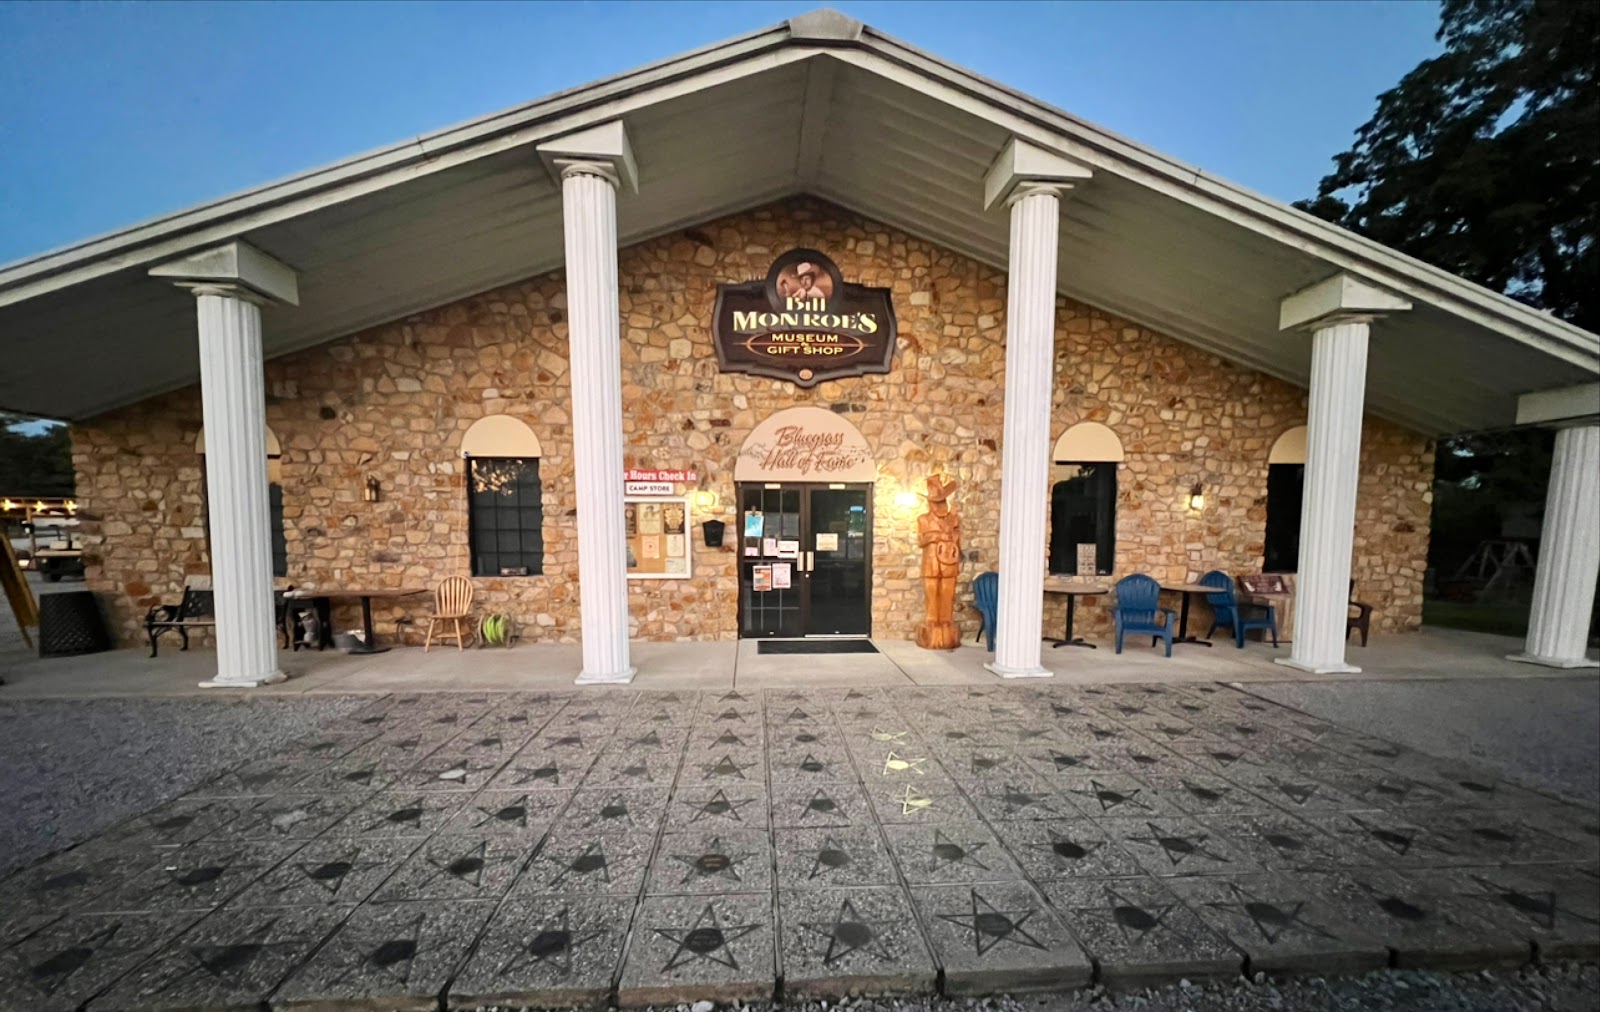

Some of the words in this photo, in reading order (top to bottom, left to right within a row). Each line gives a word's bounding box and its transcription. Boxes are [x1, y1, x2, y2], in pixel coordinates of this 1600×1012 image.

[786, 297, 826, 312] Bill
[733, 311, 878, 334] MONROE'S
[772, 333, 838, 343] MUSEUM
[767, 346, 800, 354] GIFT
[803, 346, 843, 355] SHOP
[775, 425, 844, 450] Bluegrass
[759, 447, 796, 471] Hall
[797, 451, 815, 475] of
[814, 451, 855, 471] Fame
[630, 470, 657, 481] Hours
[658, 471, 685, 481] Check
[687, 471, 697, 481] In
